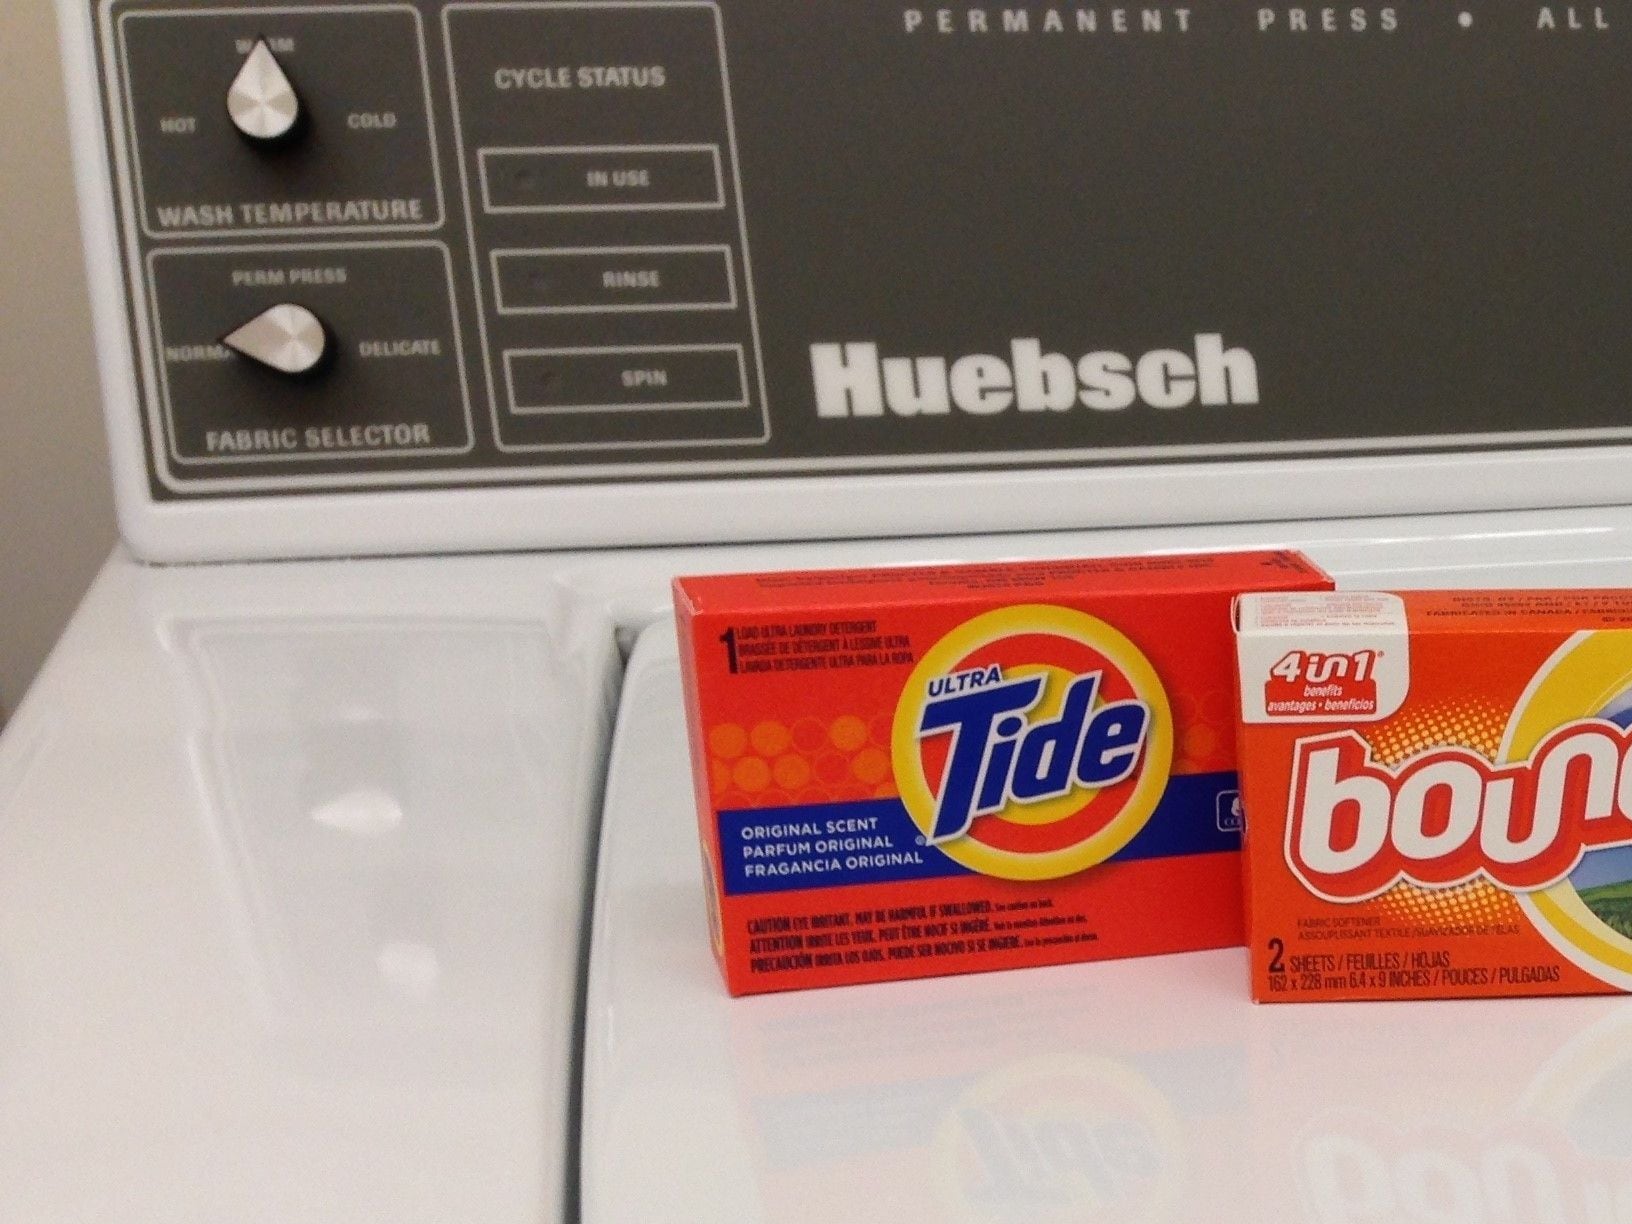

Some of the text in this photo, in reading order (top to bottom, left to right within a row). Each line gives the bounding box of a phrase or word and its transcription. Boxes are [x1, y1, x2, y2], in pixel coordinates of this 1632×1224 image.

[903, 8, 1191, 33] PERMANENT
[1257, 6, 1398, 32] PRESS
[1536, 6, 1609, 30] ALL
[495, 65, 666, 89] CYCLE STATUS
[160, 117, 196, 133] HOT
[348, 112, 397, 129] COLD
[587, 169, 649, 187] IN USE
[157, 198, 423, 227] WASH TEMPERATURE
[232, 267, 347, 287] PERM PRESS
[602, 270, 660, 288] RINSE
[165, 344, 235, 361] NORMA
[358, 338, 441, 357] DELICATE
[621, 369, 668, 387] SPIN
[809, 332, 1260, 418] Huebsch
[205, 422, 431, 452] FABRIC SELECTOR
[720, 626, 738, 674] 1
[928, 666, 1001, 697] ULTRA
[1304, 684, 1343, 697] benefits
[917, 670, 1149, 844] Tide
[741, 816, 878, 840] ORIGINAL SCENT
[743, 835, 893, 859] PARFUM ORIGINAL
[744, 851, 924, 878] FRAGANCIA ORIGINAL
[1297, 916, 1381, 928] FABRIC SOFTENER
[1268, 938, 1285, 973] 2
[1289, 954, 1336, 973] SHEETS
[1346, 952, 1400, 970] FEUILLES
[1411, 951, 1450, 968] HOJAS
[1268, 974, 1288, 992] 162
[1290, 978, 1298, 990] x
[1300, 973, 1322, 990] 228
[1324, 976, 1347, 989] mm
[1349, 971, 1367, 988] 6.4
[1369, 976, 1376, 988] x
[1379, 971, 1386, 988] 9
[1389, 969, 1430, 988] INCHES
[1441, 967, 1489, 985] POUCES
[1499, 965, 1560, 983] PULGADAS
